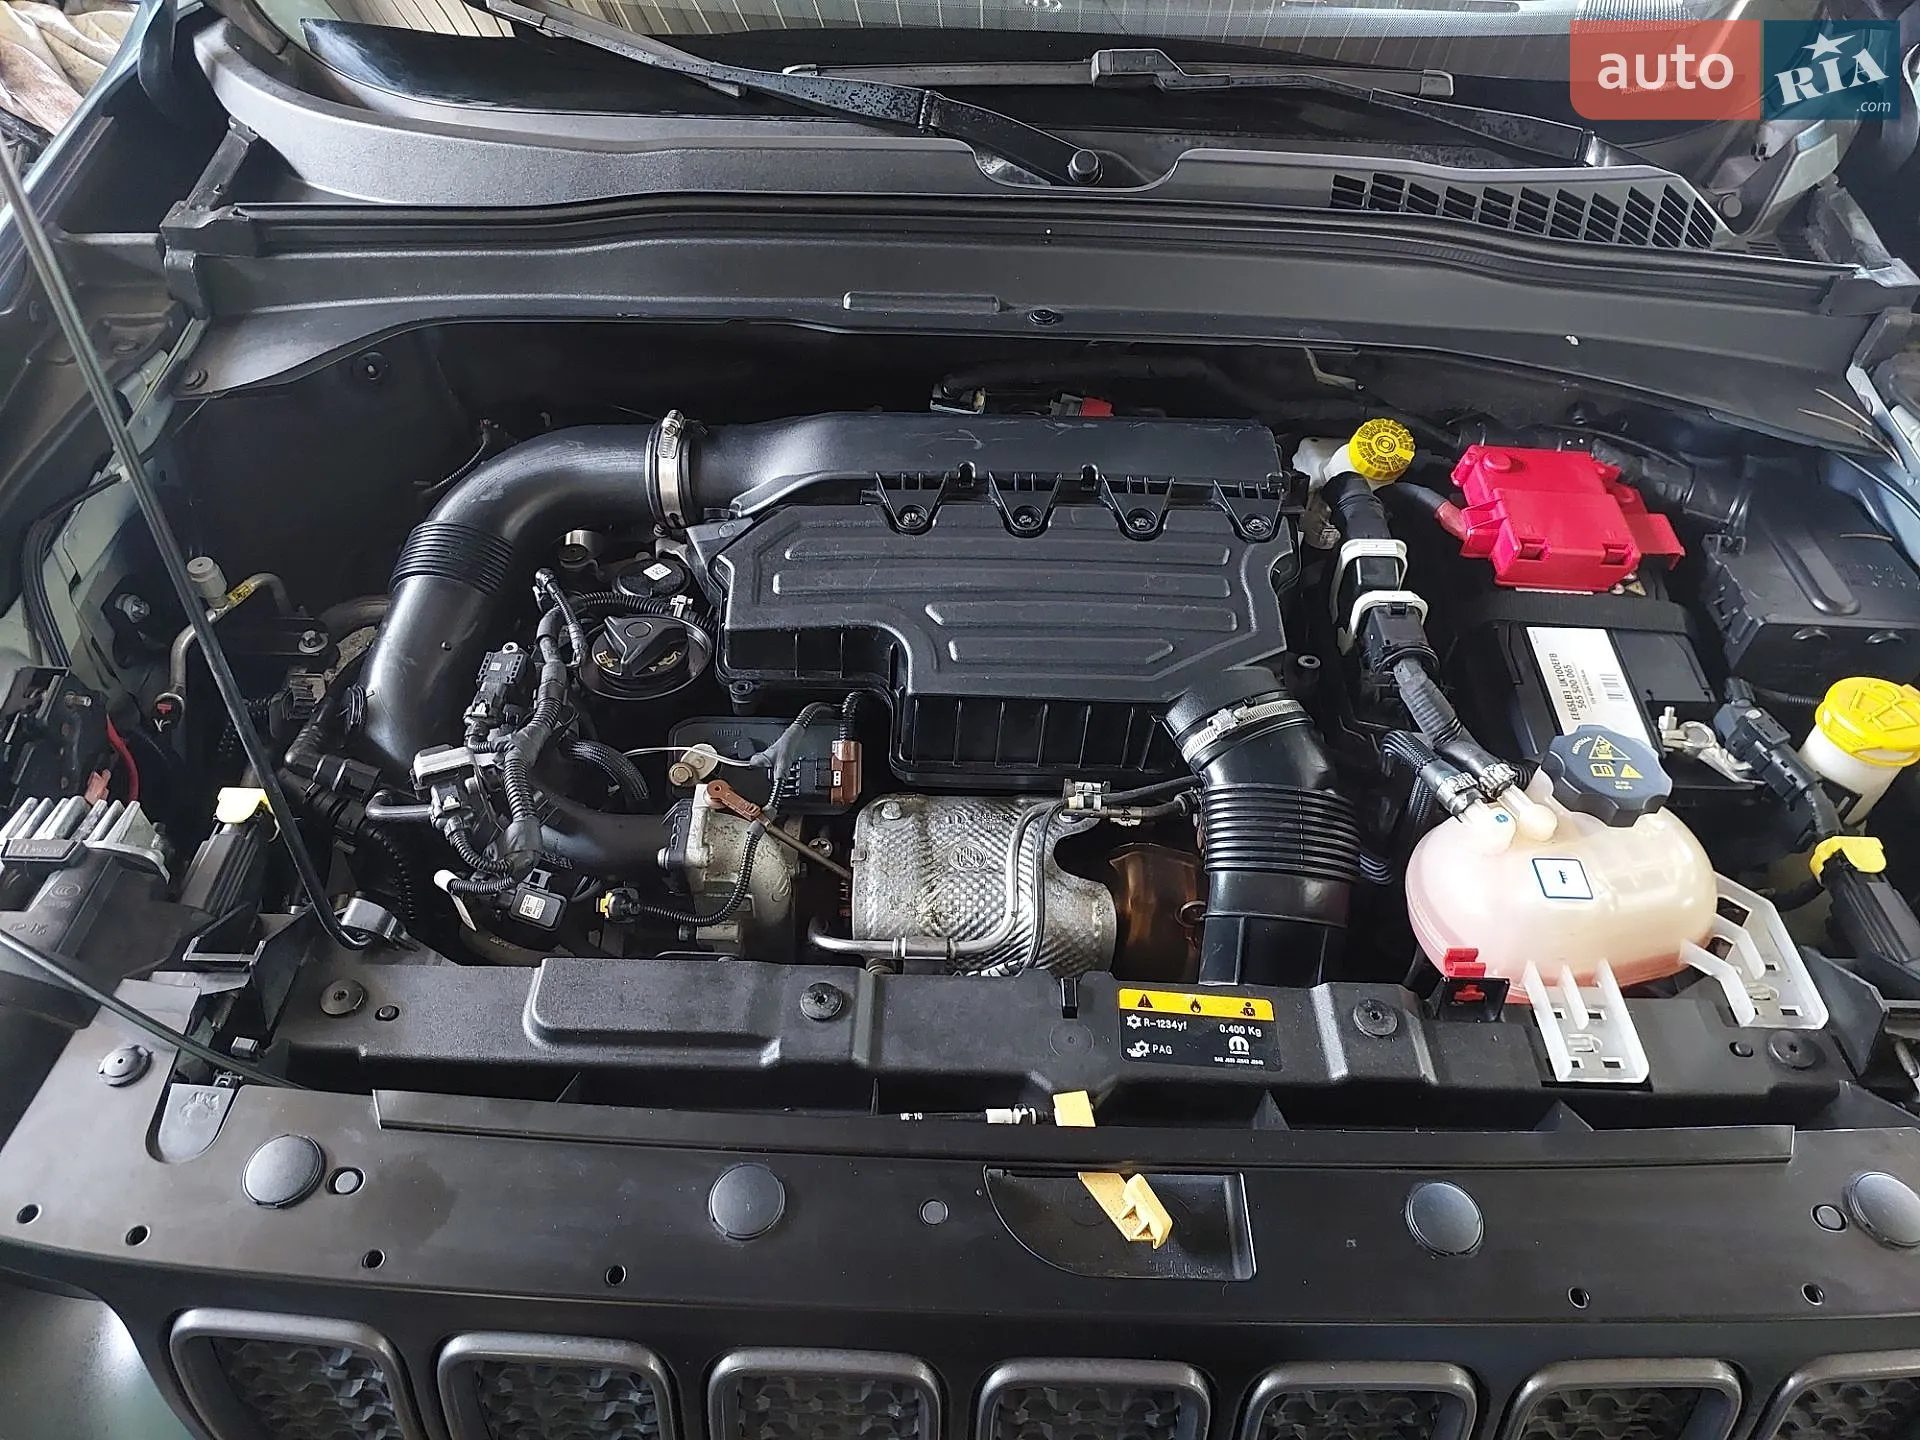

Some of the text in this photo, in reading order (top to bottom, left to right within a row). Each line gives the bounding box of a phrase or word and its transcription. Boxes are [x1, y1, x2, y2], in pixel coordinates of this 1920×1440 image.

[1219, 1023, 1246, 1035] 0.400
[1247, 1024, 1262, 1038] Kg
[1152, 1043, 1173, 1055] PAG
